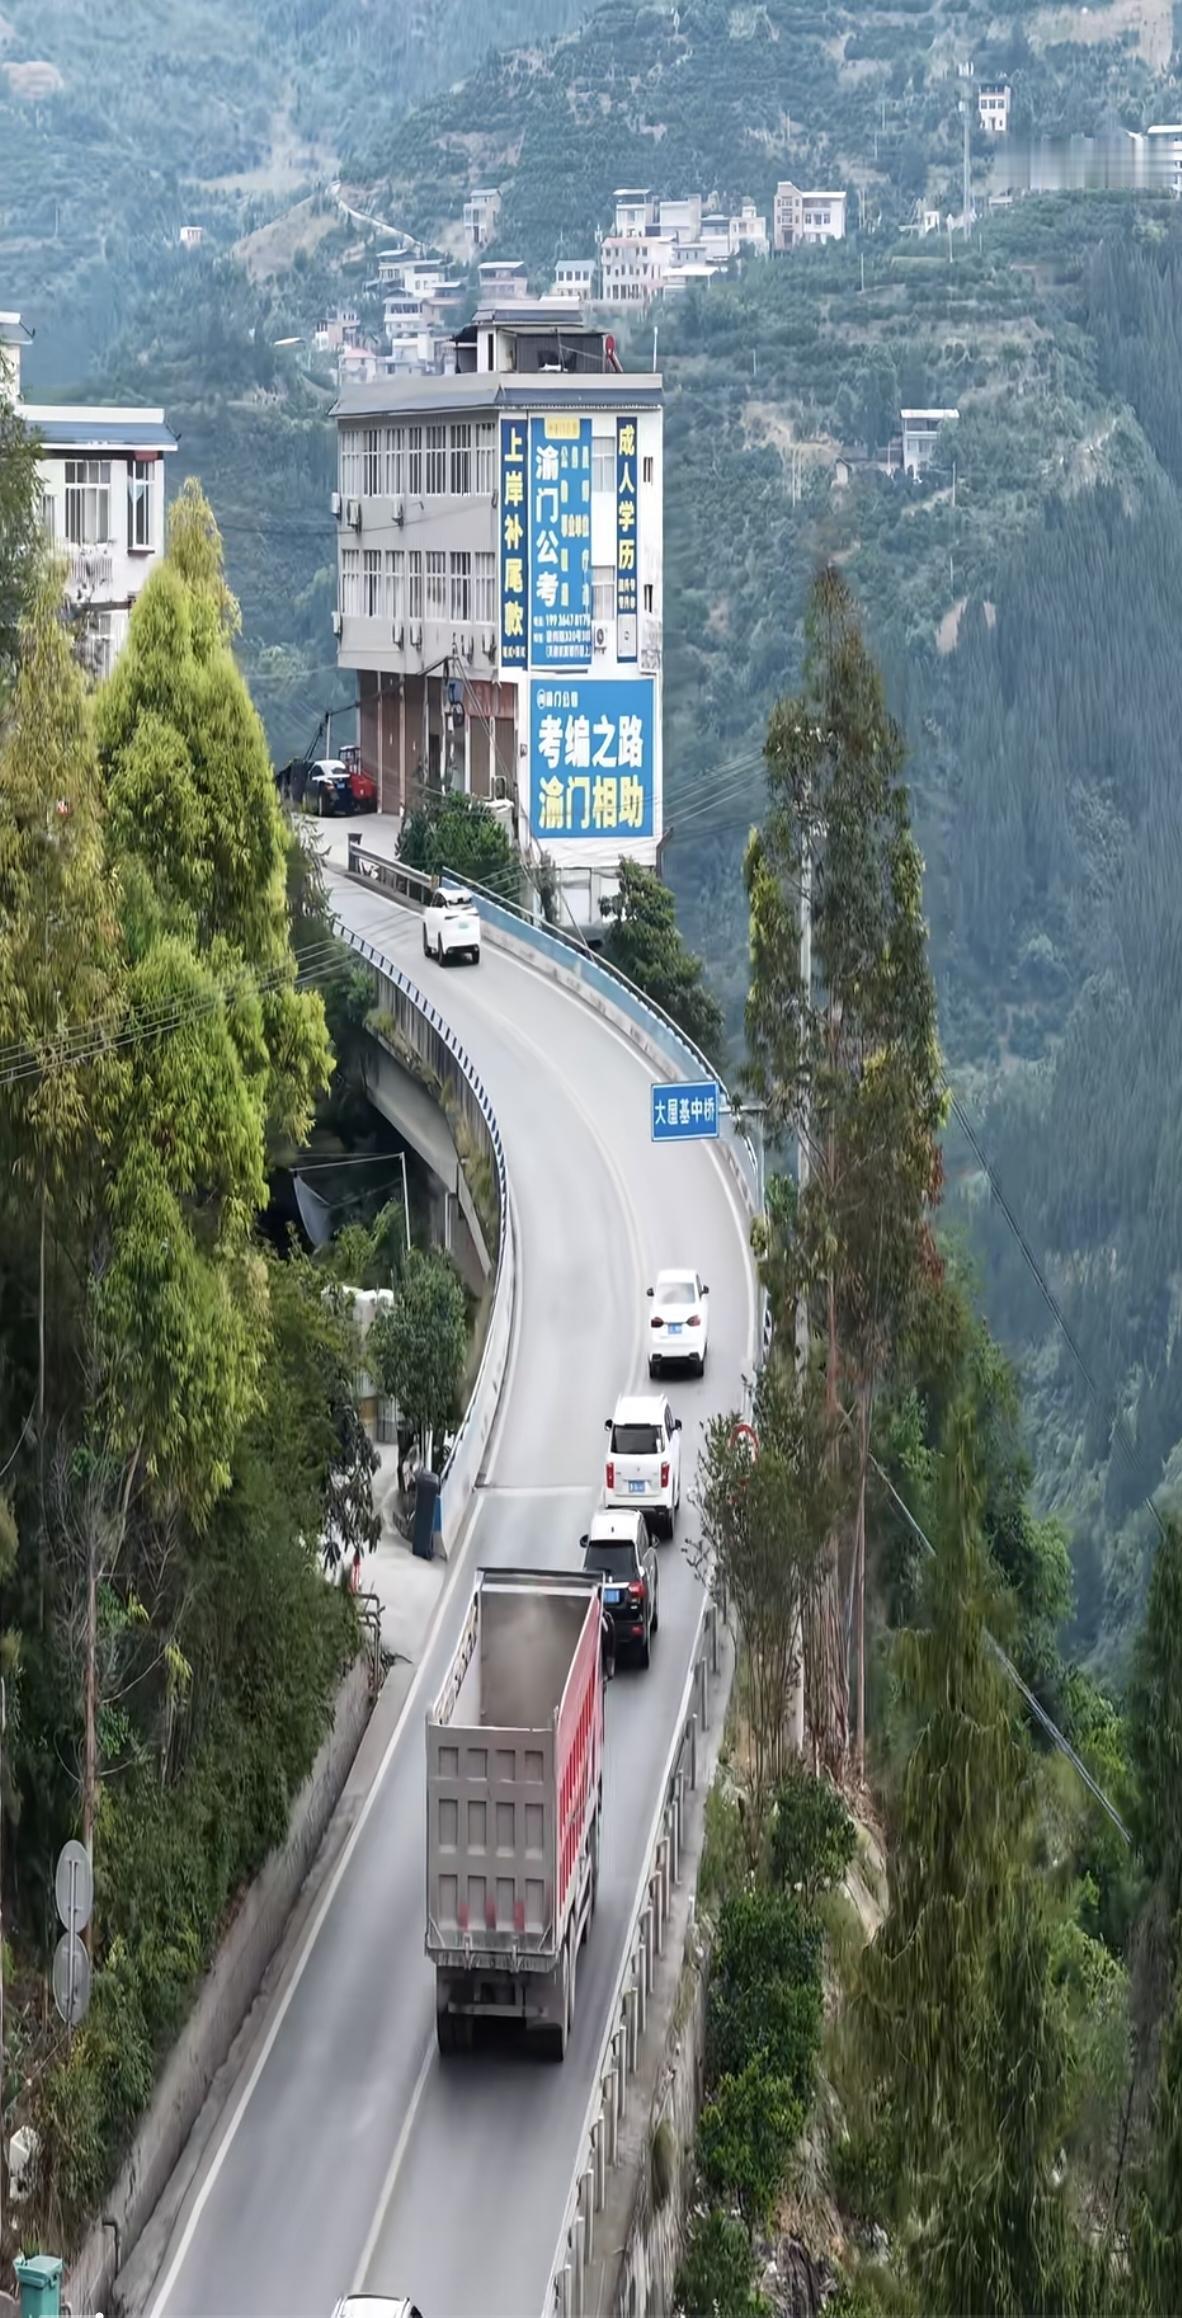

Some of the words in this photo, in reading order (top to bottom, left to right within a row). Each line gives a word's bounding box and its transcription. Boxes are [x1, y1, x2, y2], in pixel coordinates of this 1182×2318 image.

[504, 427, 524, 637] 上岸补尾款
[535, 444, 560, 608] 渝门公考
[618, 425, 635, 570] 成人学历
[538, 714, 643, 769] 考编之路
[538, 774, 644, 830] 渝门相助
